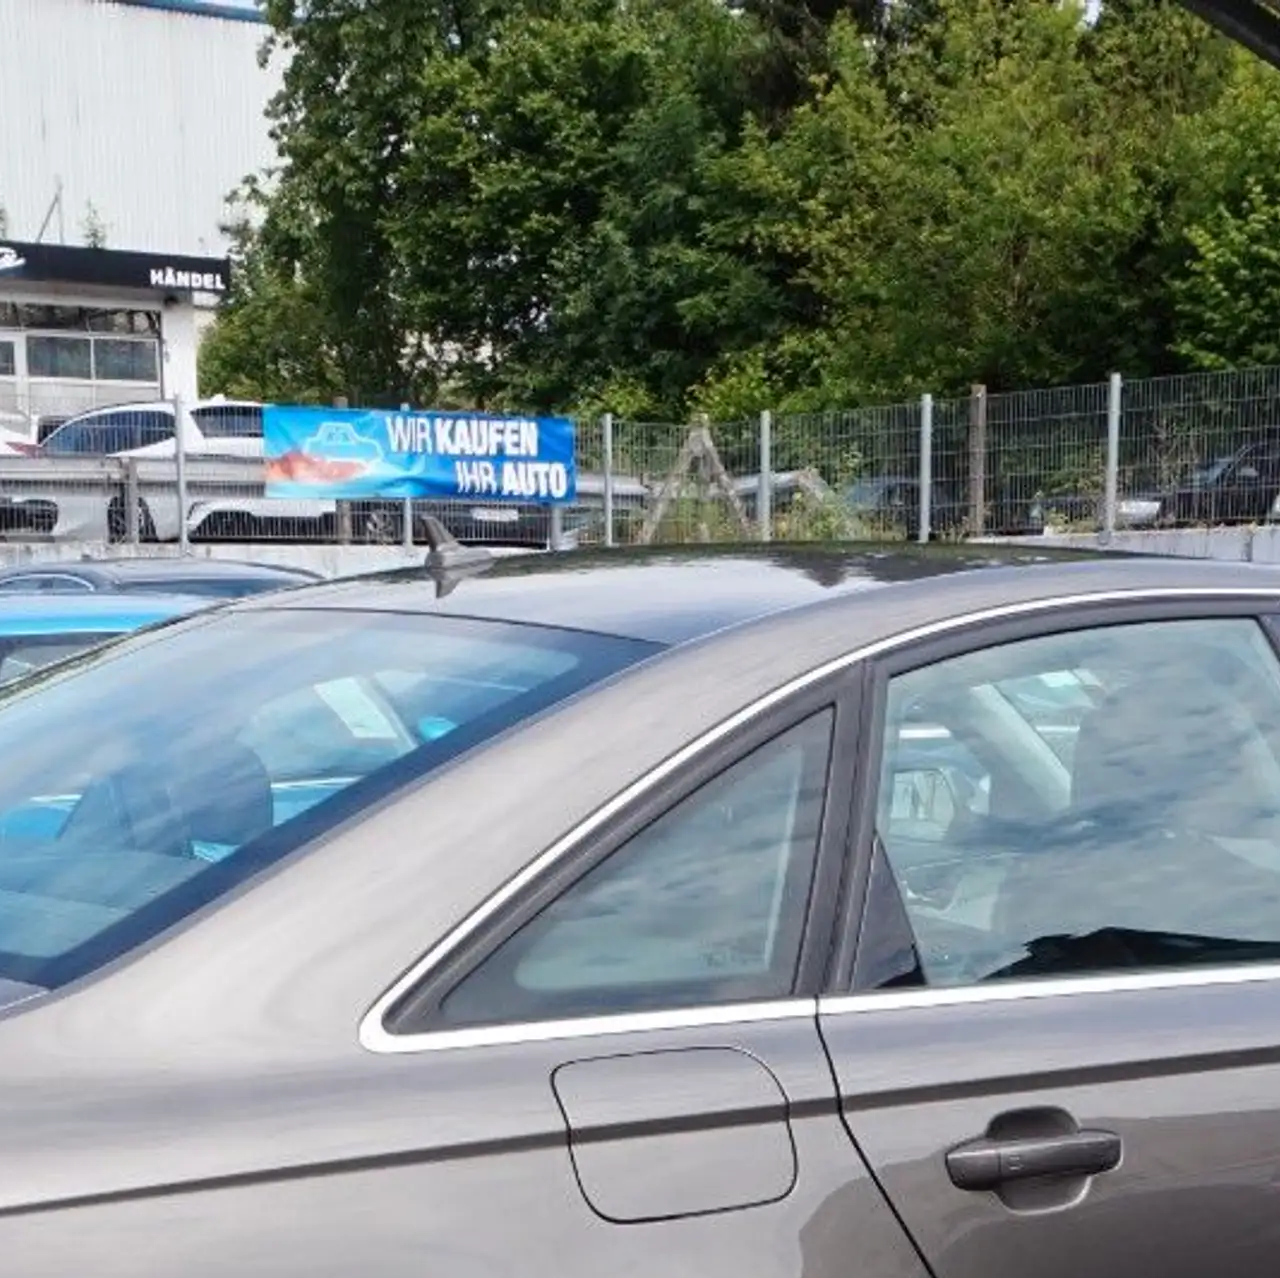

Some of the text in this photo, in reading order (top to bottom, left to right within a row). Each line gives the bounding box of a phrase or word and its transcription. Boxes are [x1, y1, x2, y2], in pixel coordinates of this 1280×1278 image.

[385, 416, 538, 457] WIR KAUFEN
[455, 461, 568, 498] IHR AUTO
